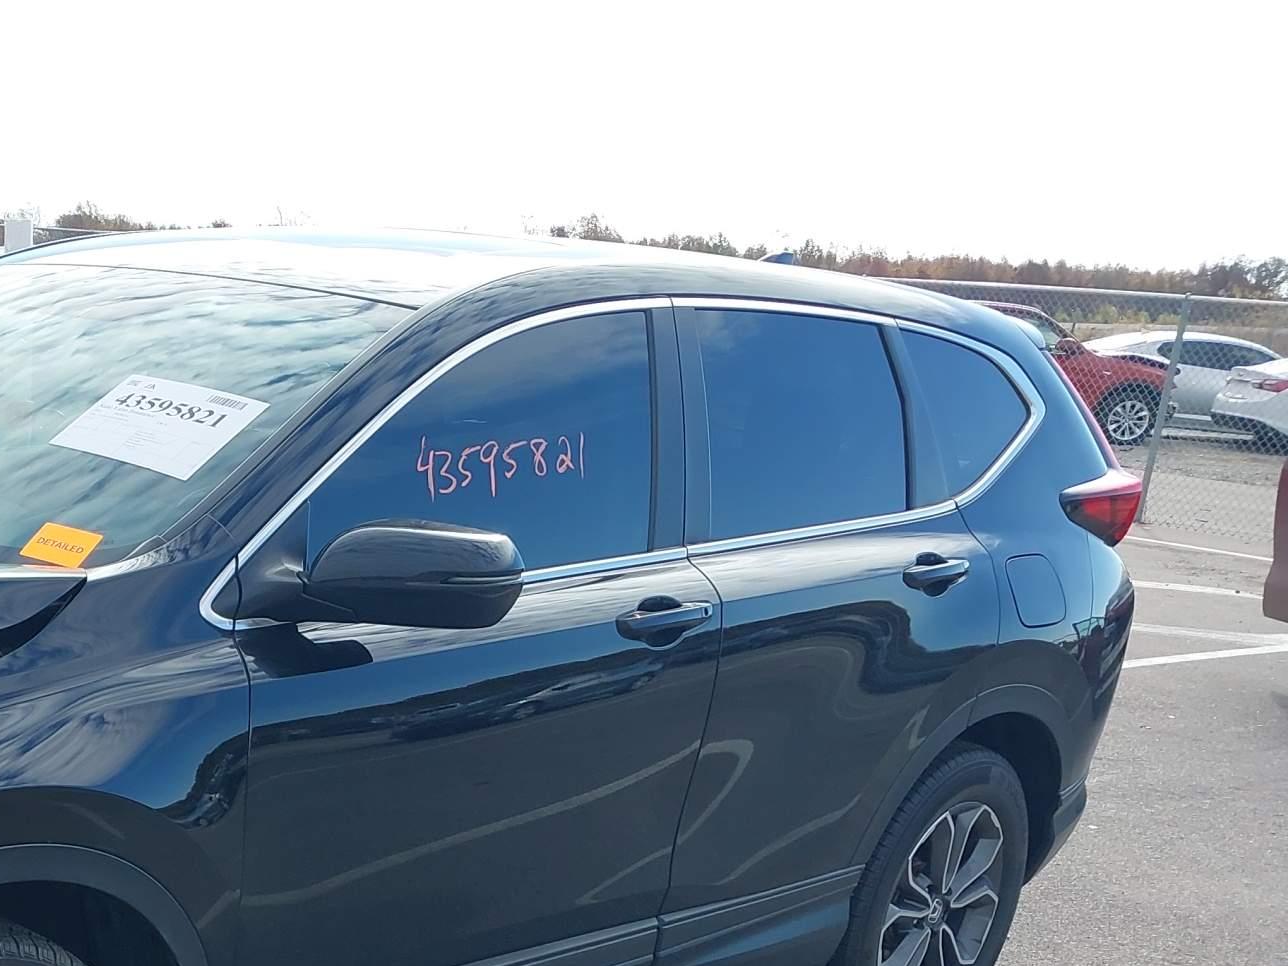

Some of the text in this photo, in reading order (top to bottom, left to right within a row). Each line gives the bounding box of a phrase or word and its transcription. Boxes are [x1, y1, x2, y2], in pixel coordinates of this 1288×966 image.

[114, 392, 228, 428] 43595821
[416, 431, 585, 502] 43595821
[36, 536, 84, 554] DETAILED
